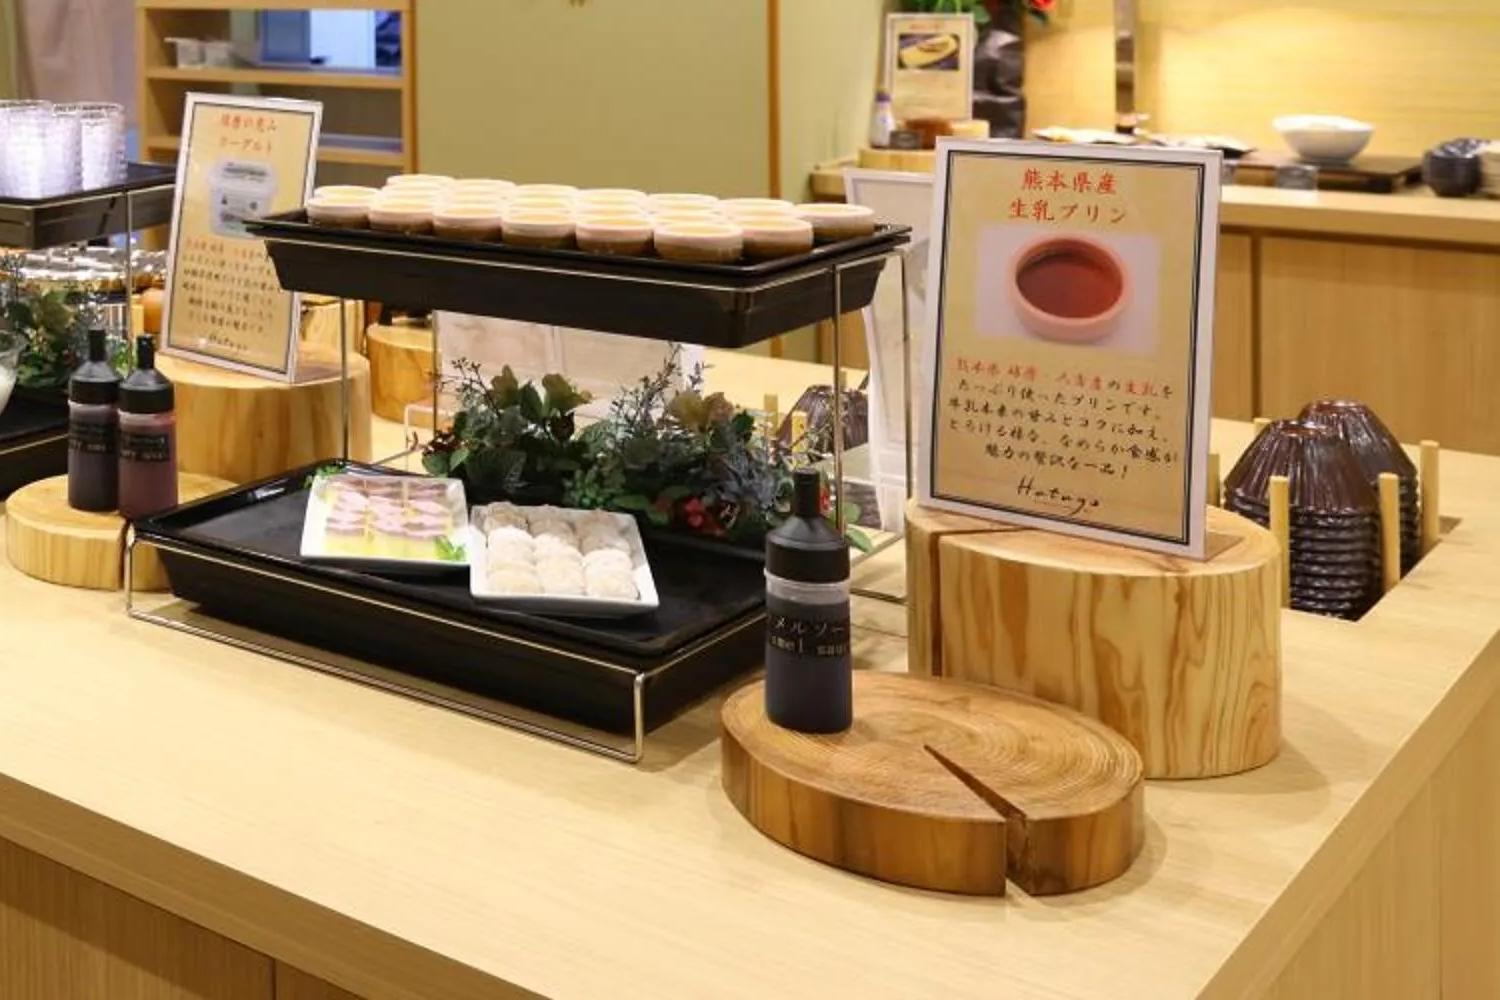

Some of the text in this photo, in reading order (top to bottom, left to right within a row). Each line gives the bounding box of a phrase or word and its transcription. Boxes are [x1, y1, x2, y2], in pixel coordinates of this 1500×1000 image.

[1021, 168, 1117, 195] 熊本県産
[1008, 197, 1126, 224] 生乳プリン
